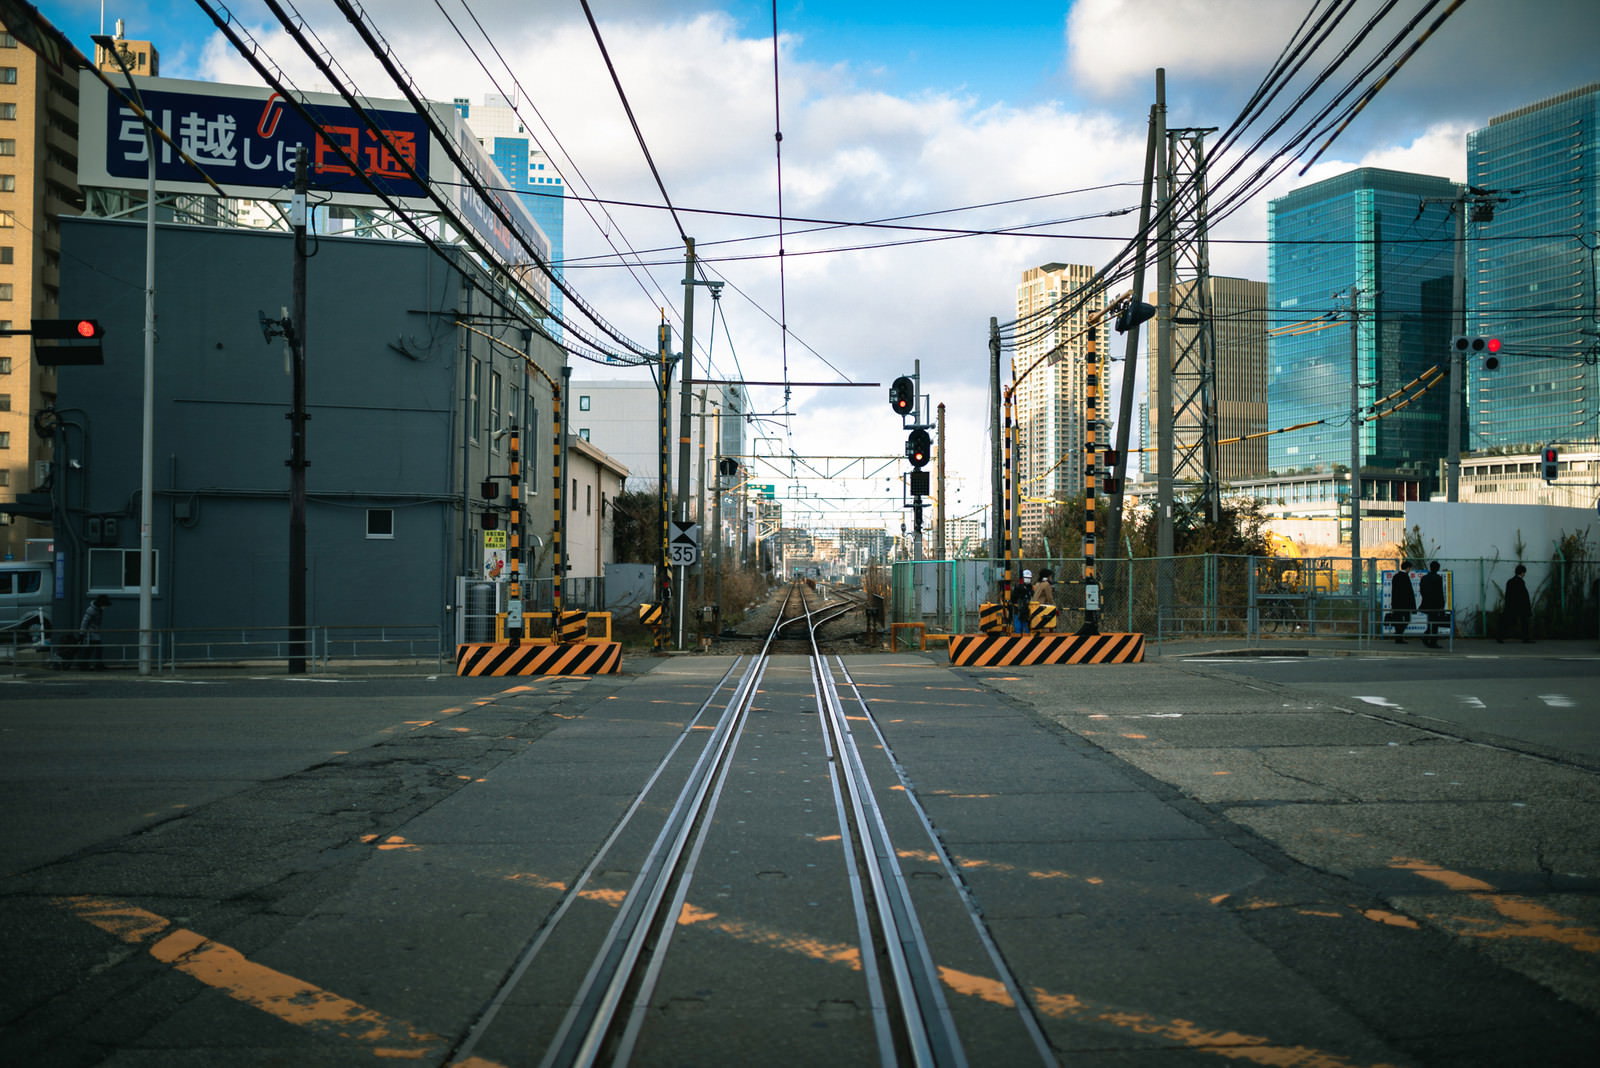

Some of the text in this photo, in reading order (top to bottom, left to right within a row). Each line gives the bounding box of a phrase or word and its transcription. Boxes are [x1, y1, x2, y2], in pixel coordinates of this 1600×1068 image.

[118, 107, 417, 180] 引越しは日通
[672, 546, 693, 562] 35
